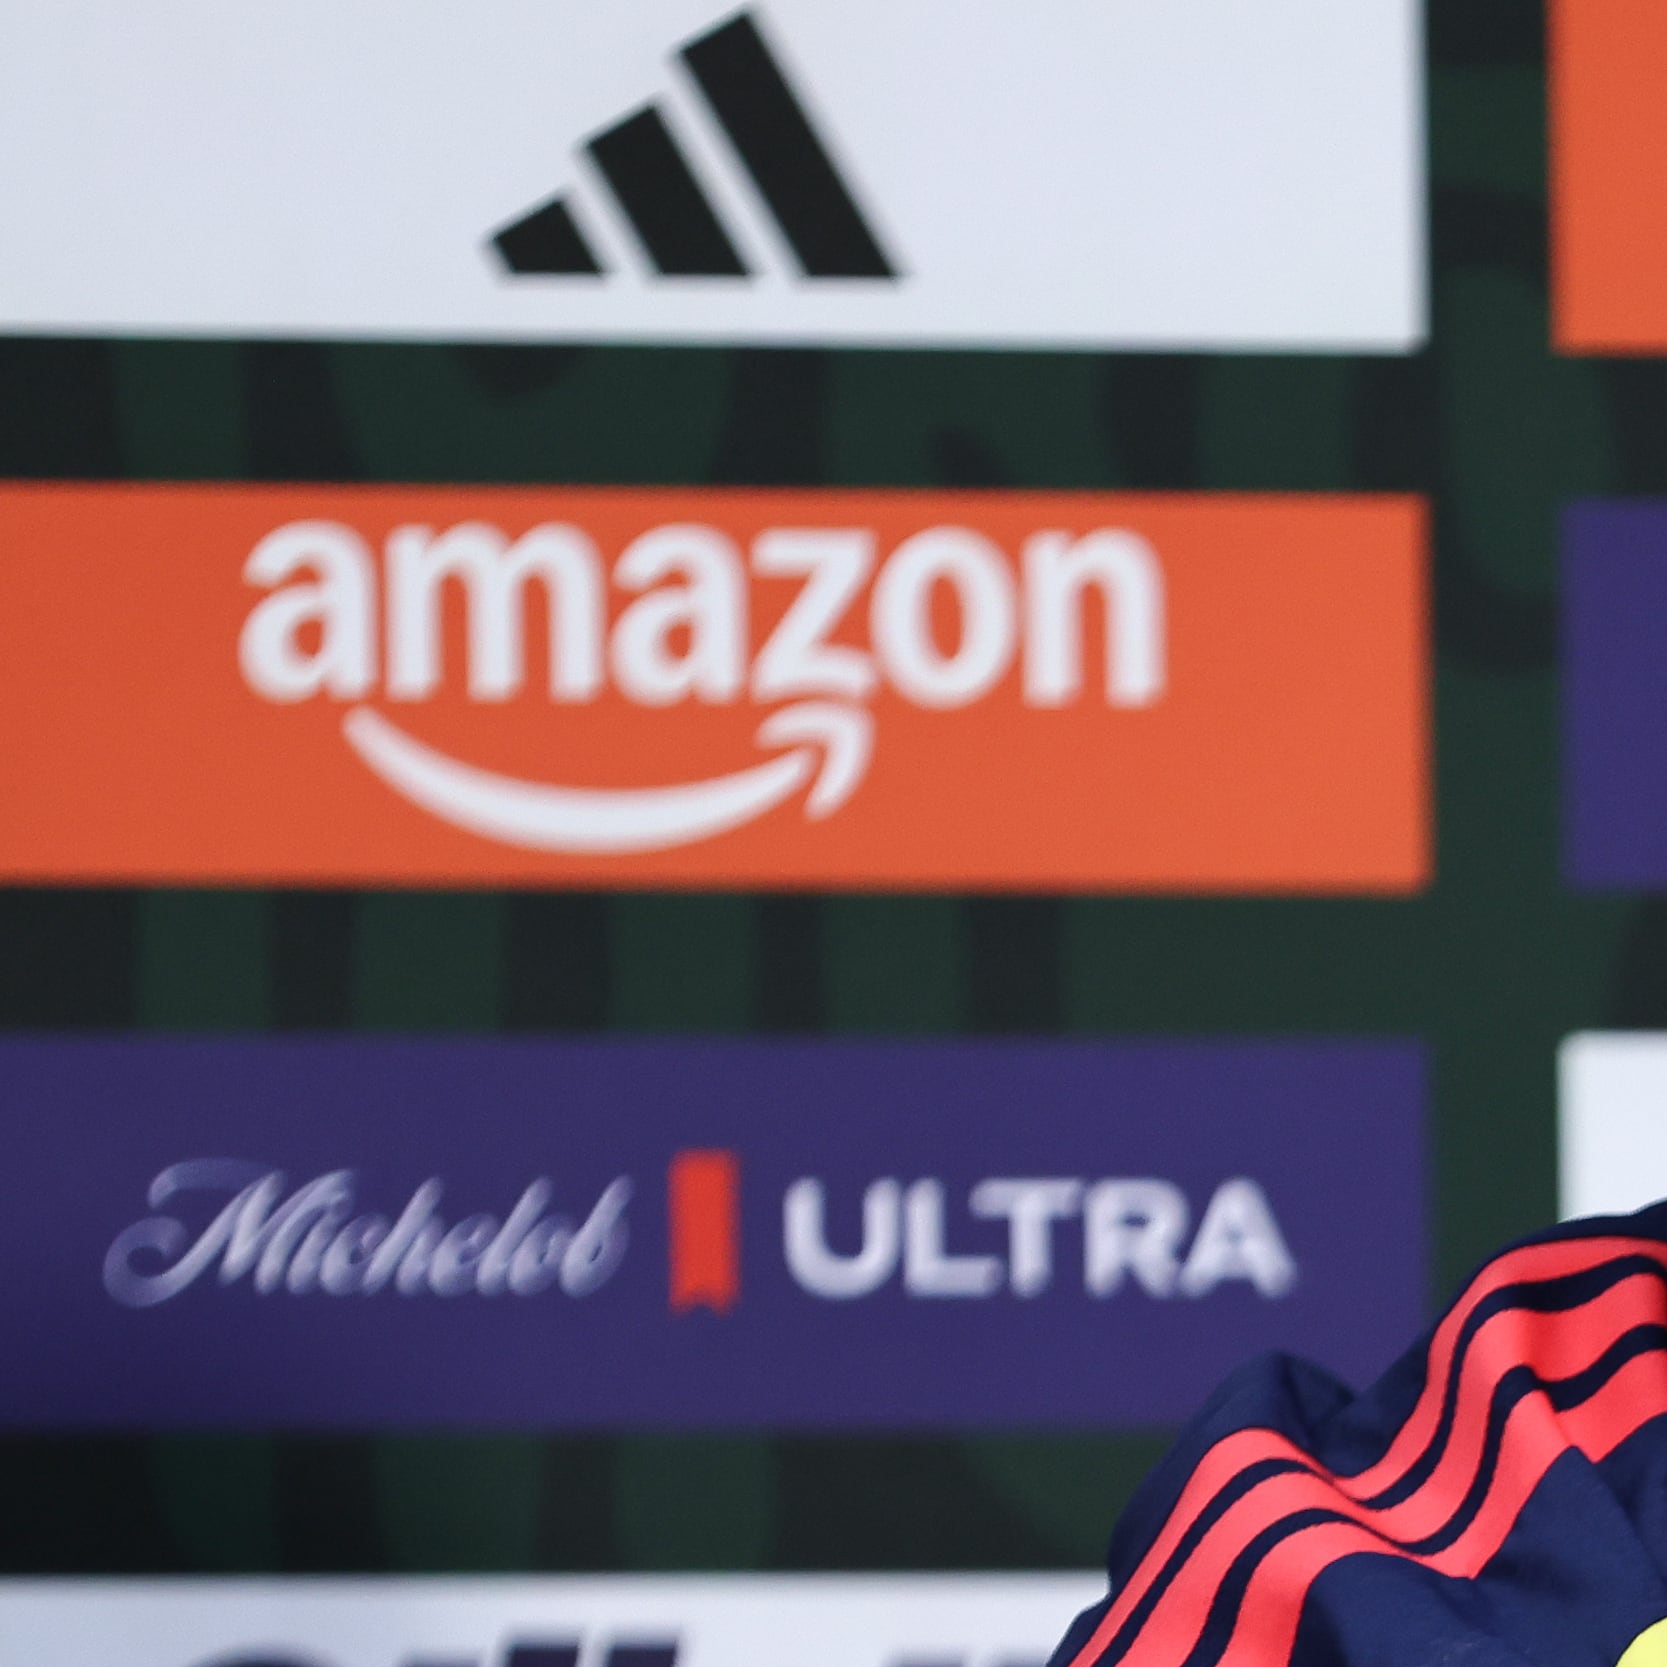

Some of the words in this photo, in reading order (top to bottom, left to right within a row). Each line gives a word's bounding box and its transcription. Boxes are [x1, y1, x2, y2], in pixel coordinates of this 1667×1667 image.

[238, 518, 1167, 708] amazon
[103, 1158, 633, 1307] Michelob
[783, 1175, 1297, 1300] ULTRA
